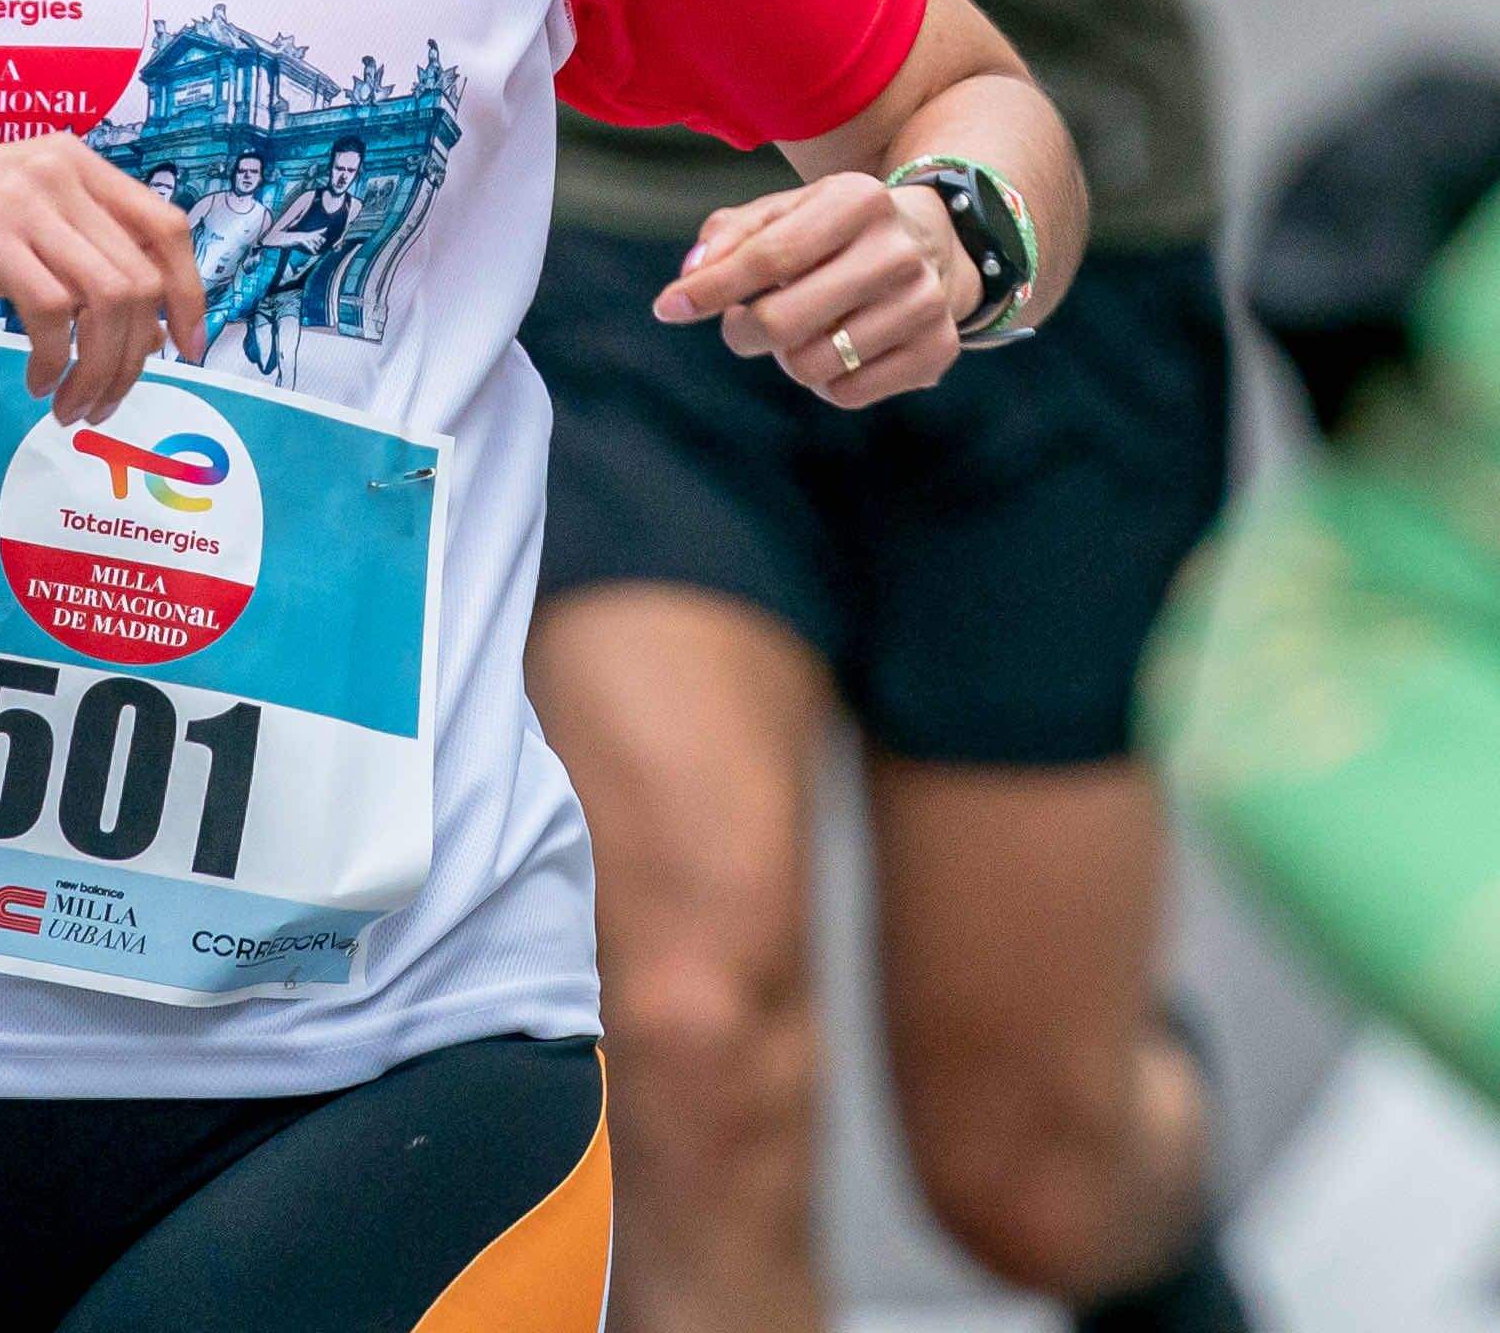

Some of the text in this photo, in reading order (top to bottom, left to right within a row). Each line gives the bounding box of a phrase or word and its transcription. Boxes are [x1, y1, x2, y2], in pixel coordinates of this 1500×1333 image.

[60, 509, 220, 554] TotalEnergies
[90, 564, 167, 595] MILLA
[53, 608, 188, 647] DE MADRID
[55, 879, 125, 900] new balance
[52, 894, 137, 928] MILLA
[48, 918, 147, 955] URBANA
